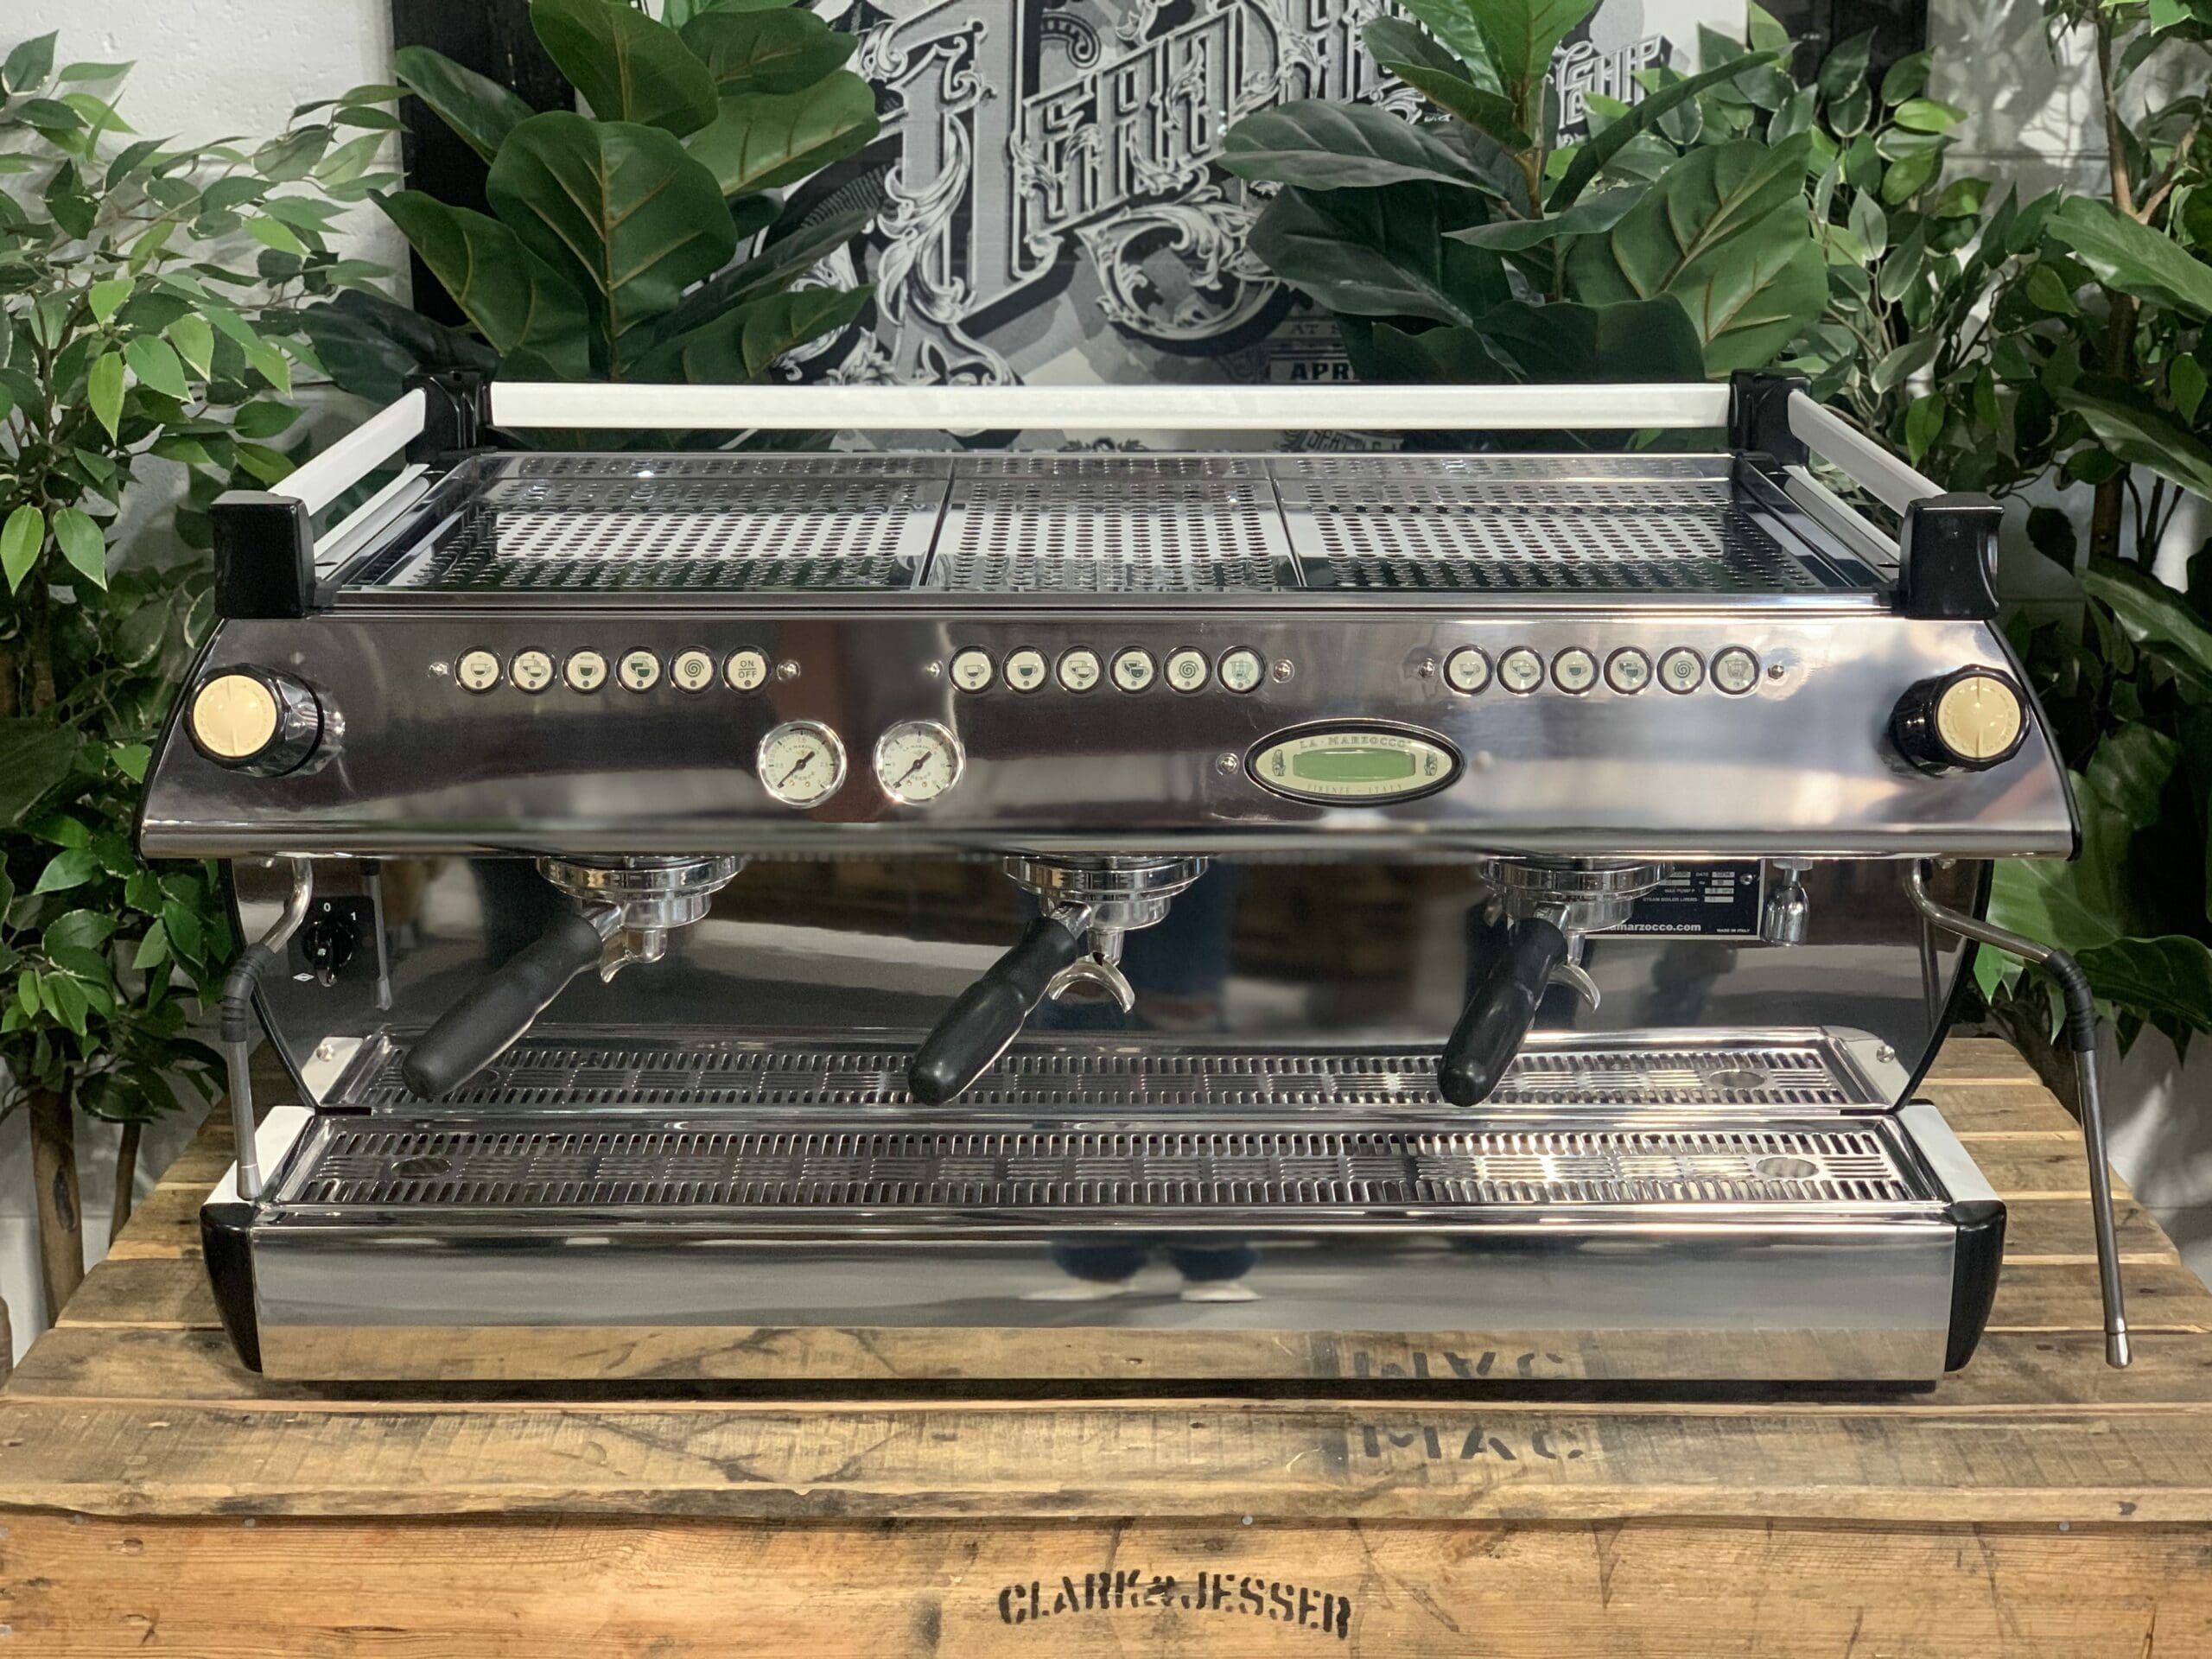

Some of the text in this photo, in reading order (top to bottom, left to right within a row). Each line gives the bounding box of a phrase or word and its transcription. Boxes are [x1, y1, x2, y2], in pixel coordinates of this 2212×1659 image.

[738, 671, 757, 679] OFF
[1300, 736, 1407, 749] LA MARZOCCO
[351, 912, 356, 921] 1
